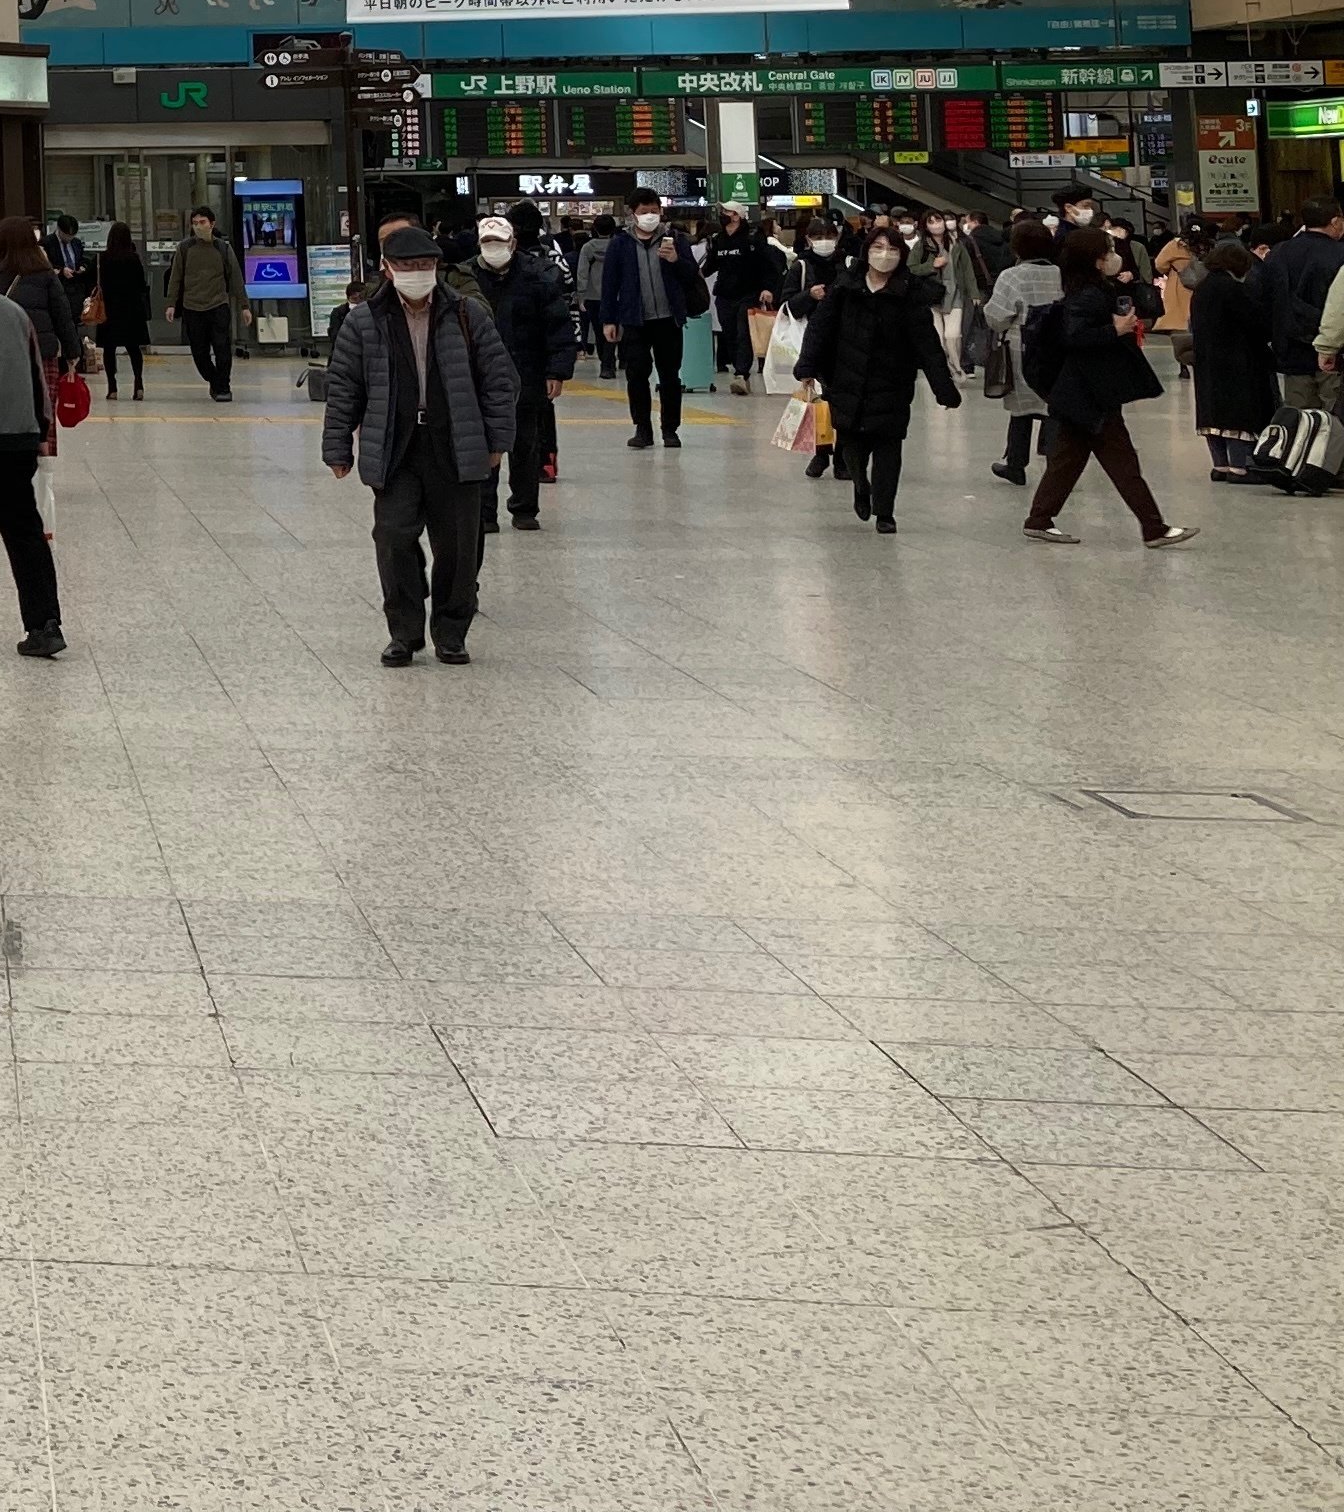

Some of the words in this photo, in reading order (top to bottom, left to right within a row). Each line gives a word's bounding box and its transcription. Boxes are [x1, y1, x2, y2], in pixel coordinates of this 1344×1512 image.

[460, 74, 488, 90] JR
[677, 72, 763, 93] 中央改札
[768, 70, 808, 81] Central
[810, 70, 836, 80] Gate
[876, 75, 887, 84] JK
[897, 74, 909, 84] JY
[919, 73, 932, 83] JU
[1060, 67, 1115, 86] 新幹線
[494, 74, 557, 95] 上野駅
[562, 85, 591, 95] Ueno
[593, 84, 631, 95] Station
[160, 81, 209, 109] JR
[1235, 118, 1252, 132] 3F
[518, 174, 594, 194] 駅弁屋
